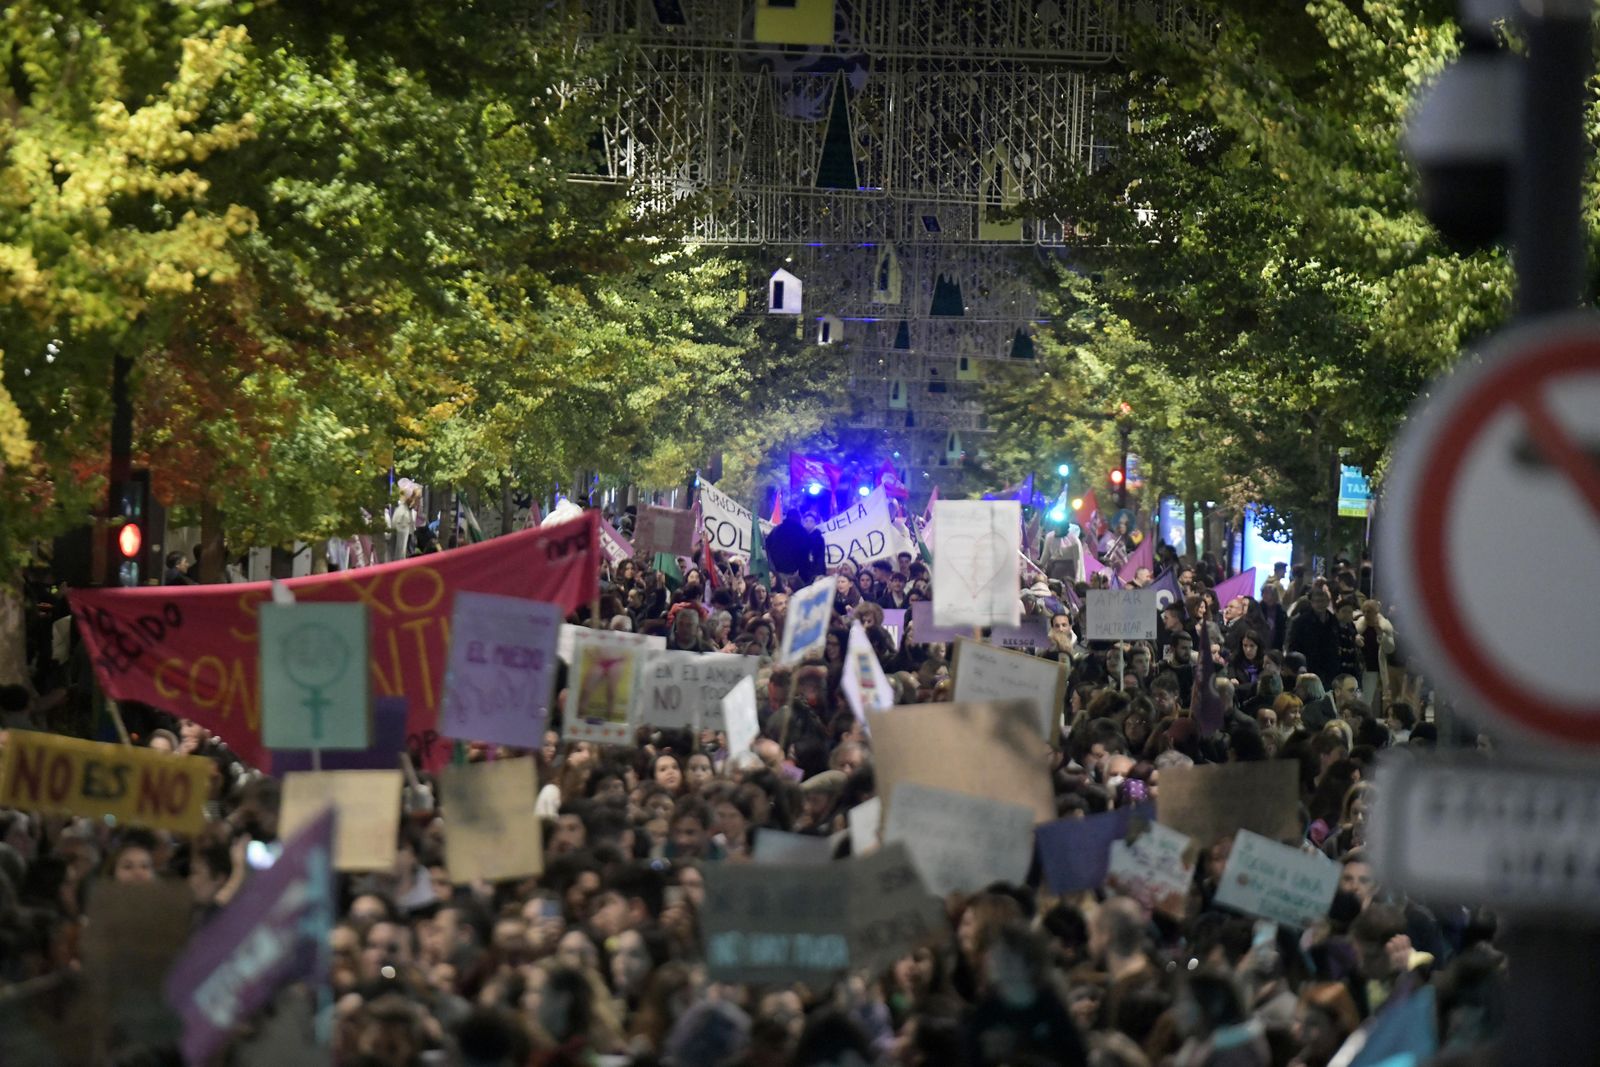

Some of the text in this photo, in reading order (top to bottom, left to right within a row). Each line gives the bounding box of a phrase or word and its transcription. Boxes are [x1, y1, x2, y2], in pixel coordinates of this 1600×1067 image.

[825, 529, 885, 565] DAD
[231, 565, 445, 644] SXO
[653, 684, 683, 711] NO
[10, 743, 193, 816] NO ES NO
